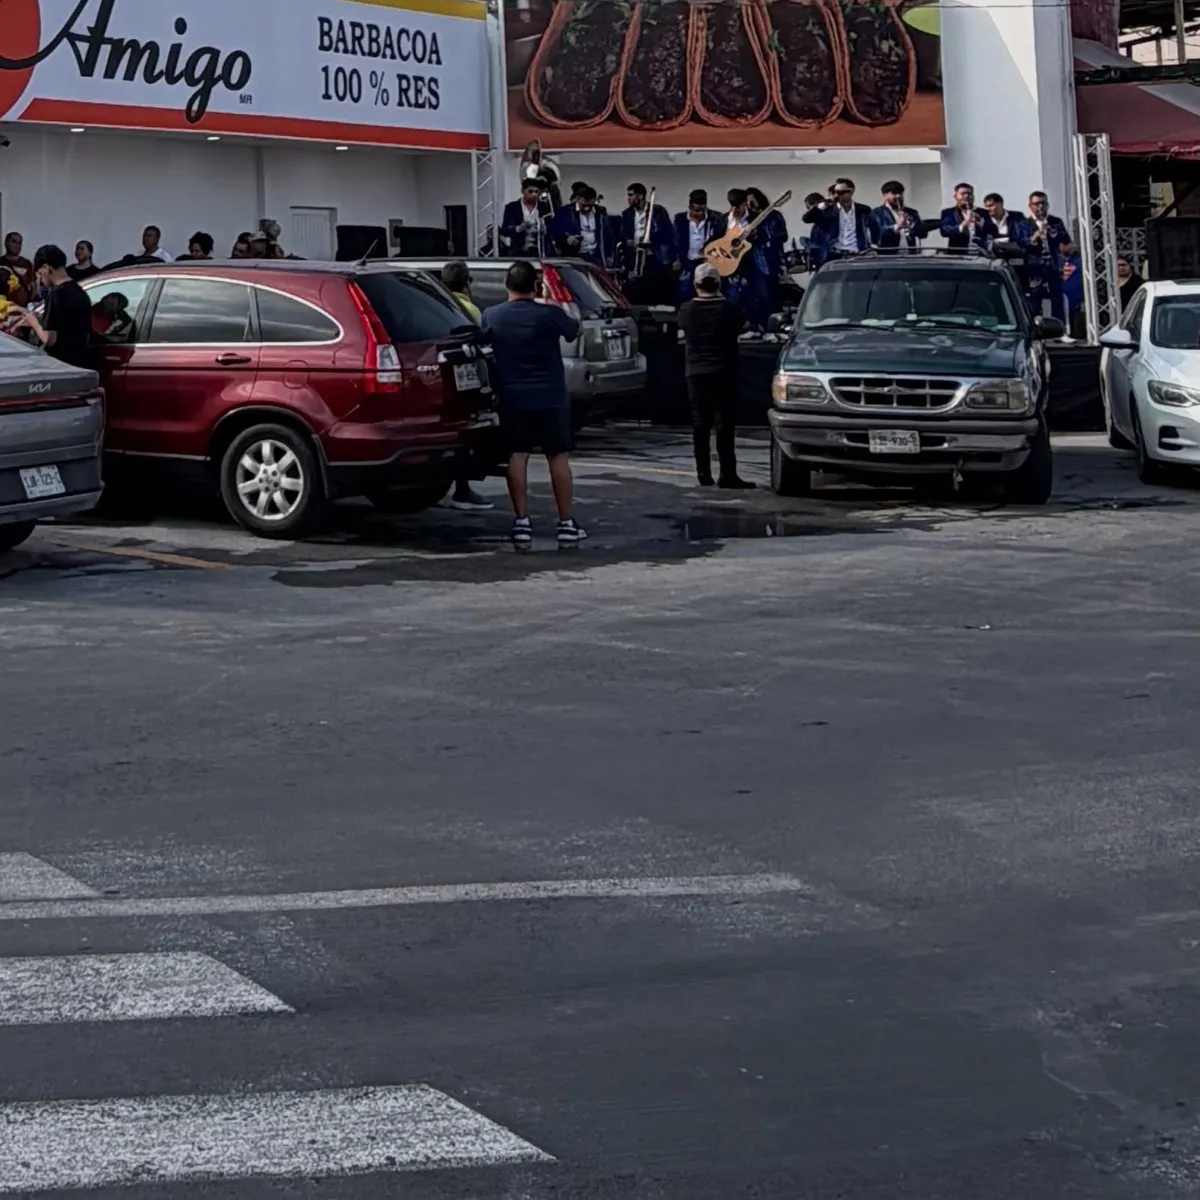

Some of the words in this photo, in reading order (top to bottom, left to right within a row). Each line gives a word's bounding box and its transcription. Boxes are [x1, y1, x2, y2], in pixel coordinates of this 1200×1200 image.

[317, 16, 442, 66] BARBACOA
[321, 64, 362, 104] 100
[396, 73, 440, 110] RES
